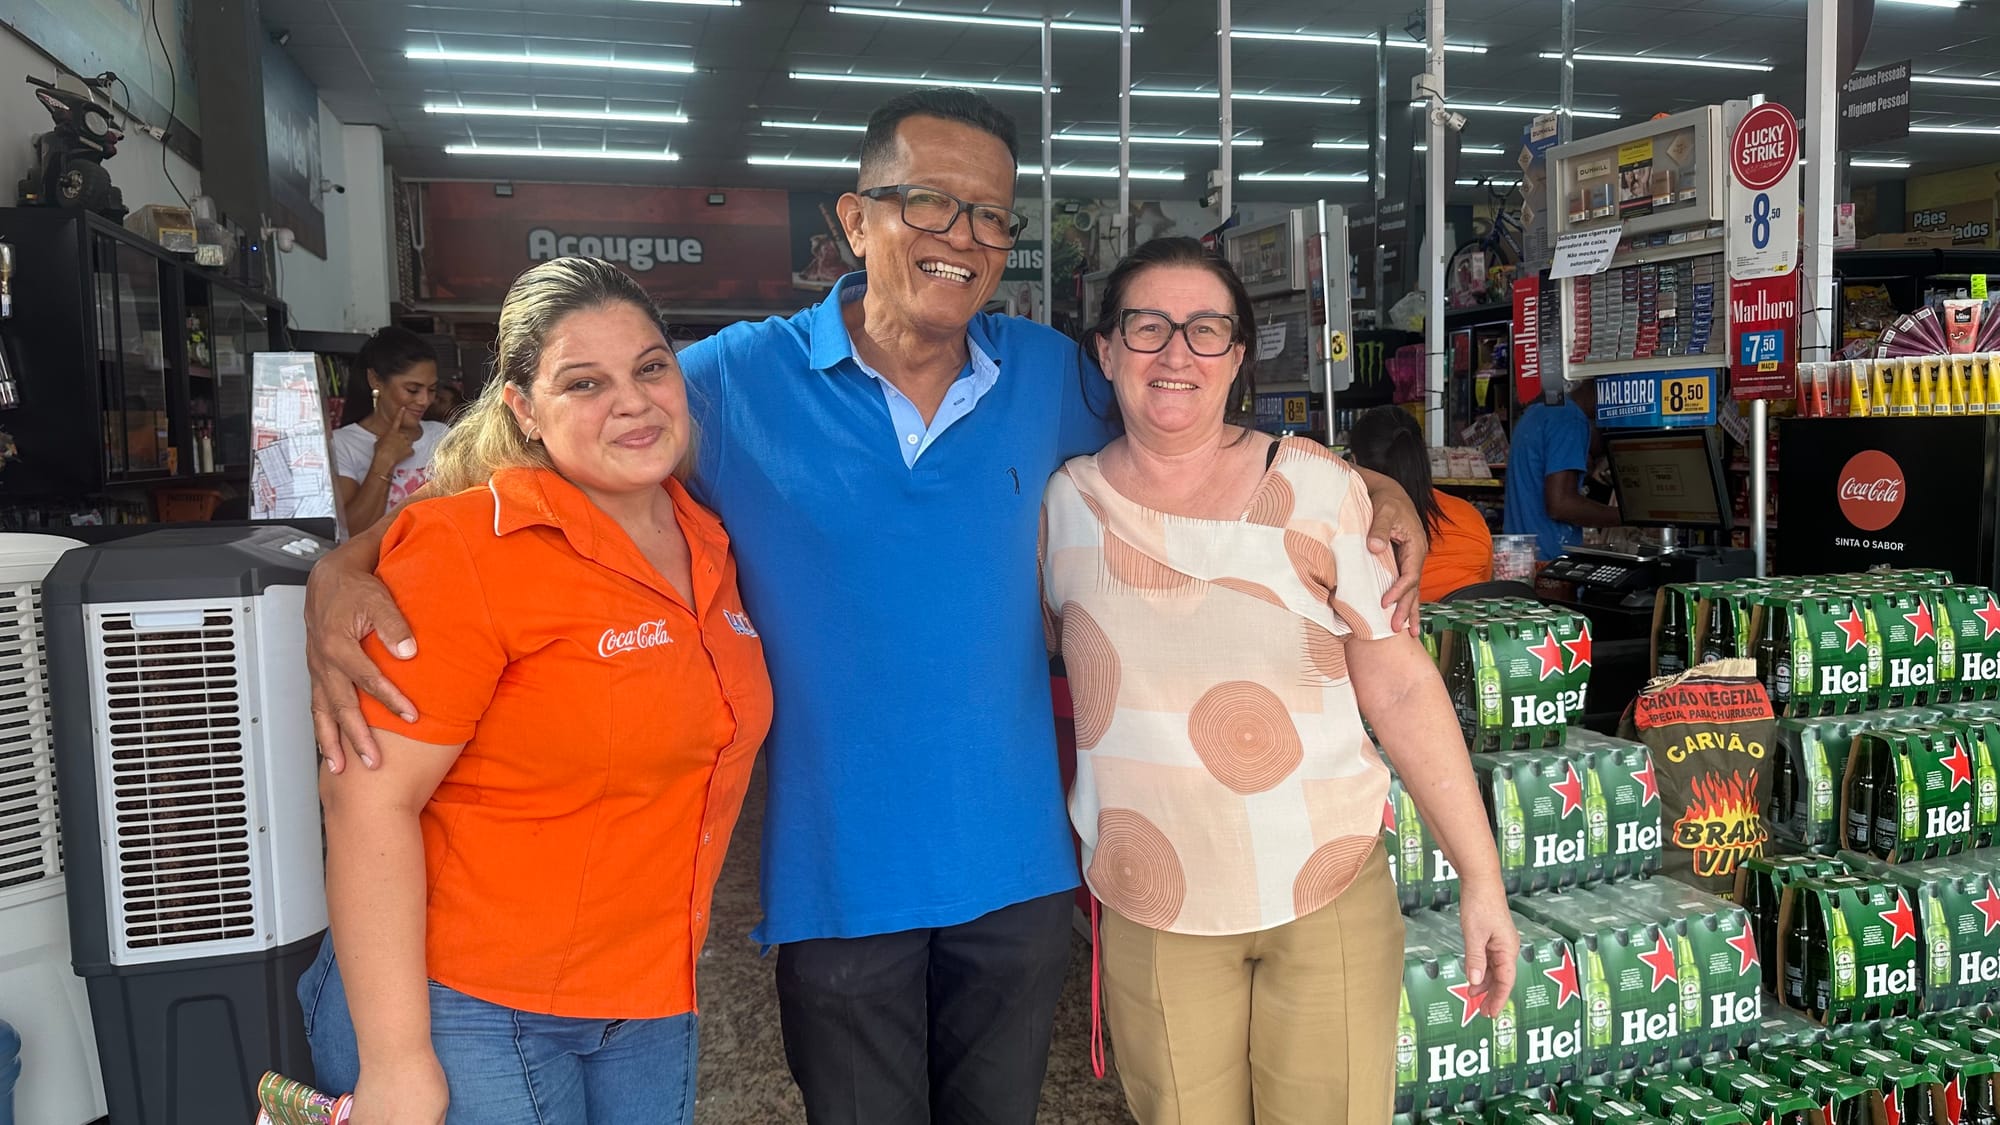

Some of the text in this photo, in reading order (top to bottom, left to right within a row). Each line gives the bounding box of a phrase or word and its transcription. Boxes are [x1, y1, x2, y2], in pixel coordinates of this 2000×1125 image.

[1848, 65, 1906, 93] Cuidados Pessoais
[1848, 91, 1908, 119] Higiene Pessoal
[1744, 124, 1785, 148] LUCKY
[1742, 141, 1785, 165] STRIKE
[1913, 210, 1946, 227] Pães
[1733, 289, 1794, 323] Marlboro
[1514, 296, 1539, 378] Marlboro
[1597, 379, 1655, 405] MARLBORO
[1670, 382, 1704, 412] 8,50
[1618, 405, 1646, 416] SELECTION
[1840, 477, 1902, 502] Coca-Cola
[1835, 537, 1904, 552] SINTA O SABOR
[598, 619, 673, 658] Coca-Cola
[1820, 663, 1868, 695] Hei
[1890, 656, 1935, 688] Hei
[1511, 692, 1567, 728] Hei
[1640, 688, 1763, 712] CARVÃO VEGETAL
[1666, 731, 1765, 763] CARVÃO
[1615, 817, 1663, 855] Hei
[1926, 802, 1971, 839] Hei
[1533, 829, 1585, 868] Hei
[1863, 959, 1917, 998] Hei
[1710, 985, 1762, 1029] Hei
[1621, 1002, 1678, 1045] Hei
[1526, 1019, 1582, 1065] Hei
[1427, 1037, 1491, 1083] Hei
